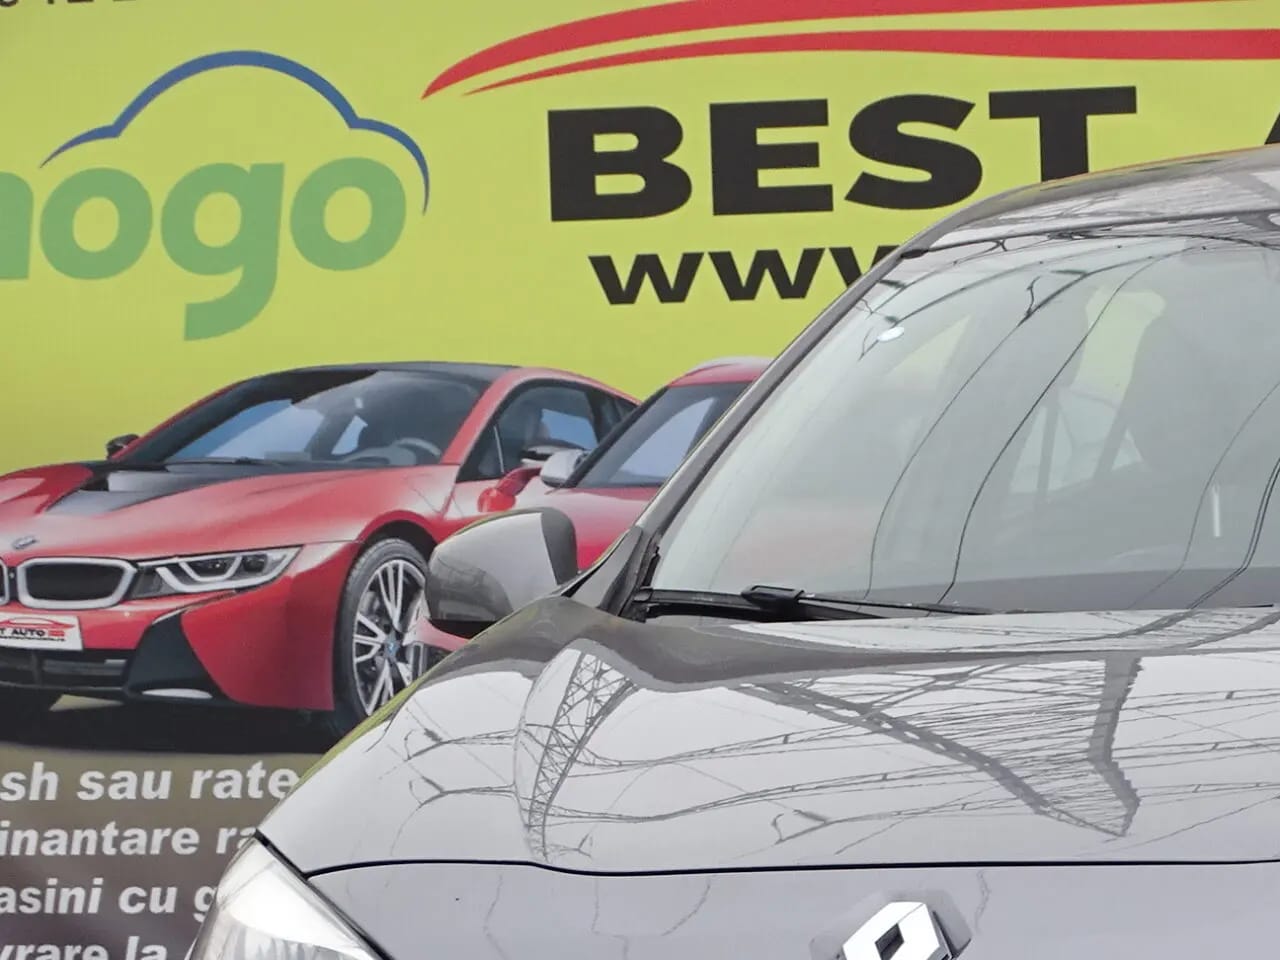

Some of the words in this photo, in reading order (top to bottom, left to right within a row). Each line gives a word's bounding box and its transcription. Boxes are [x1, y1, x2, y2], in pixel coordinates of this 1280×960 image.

[547, 86, 1137, 222] BEST
[77, 769, 172, 800] sau
[190, 761, 301, 800] rate
[118, 886, 176, 914] cu
